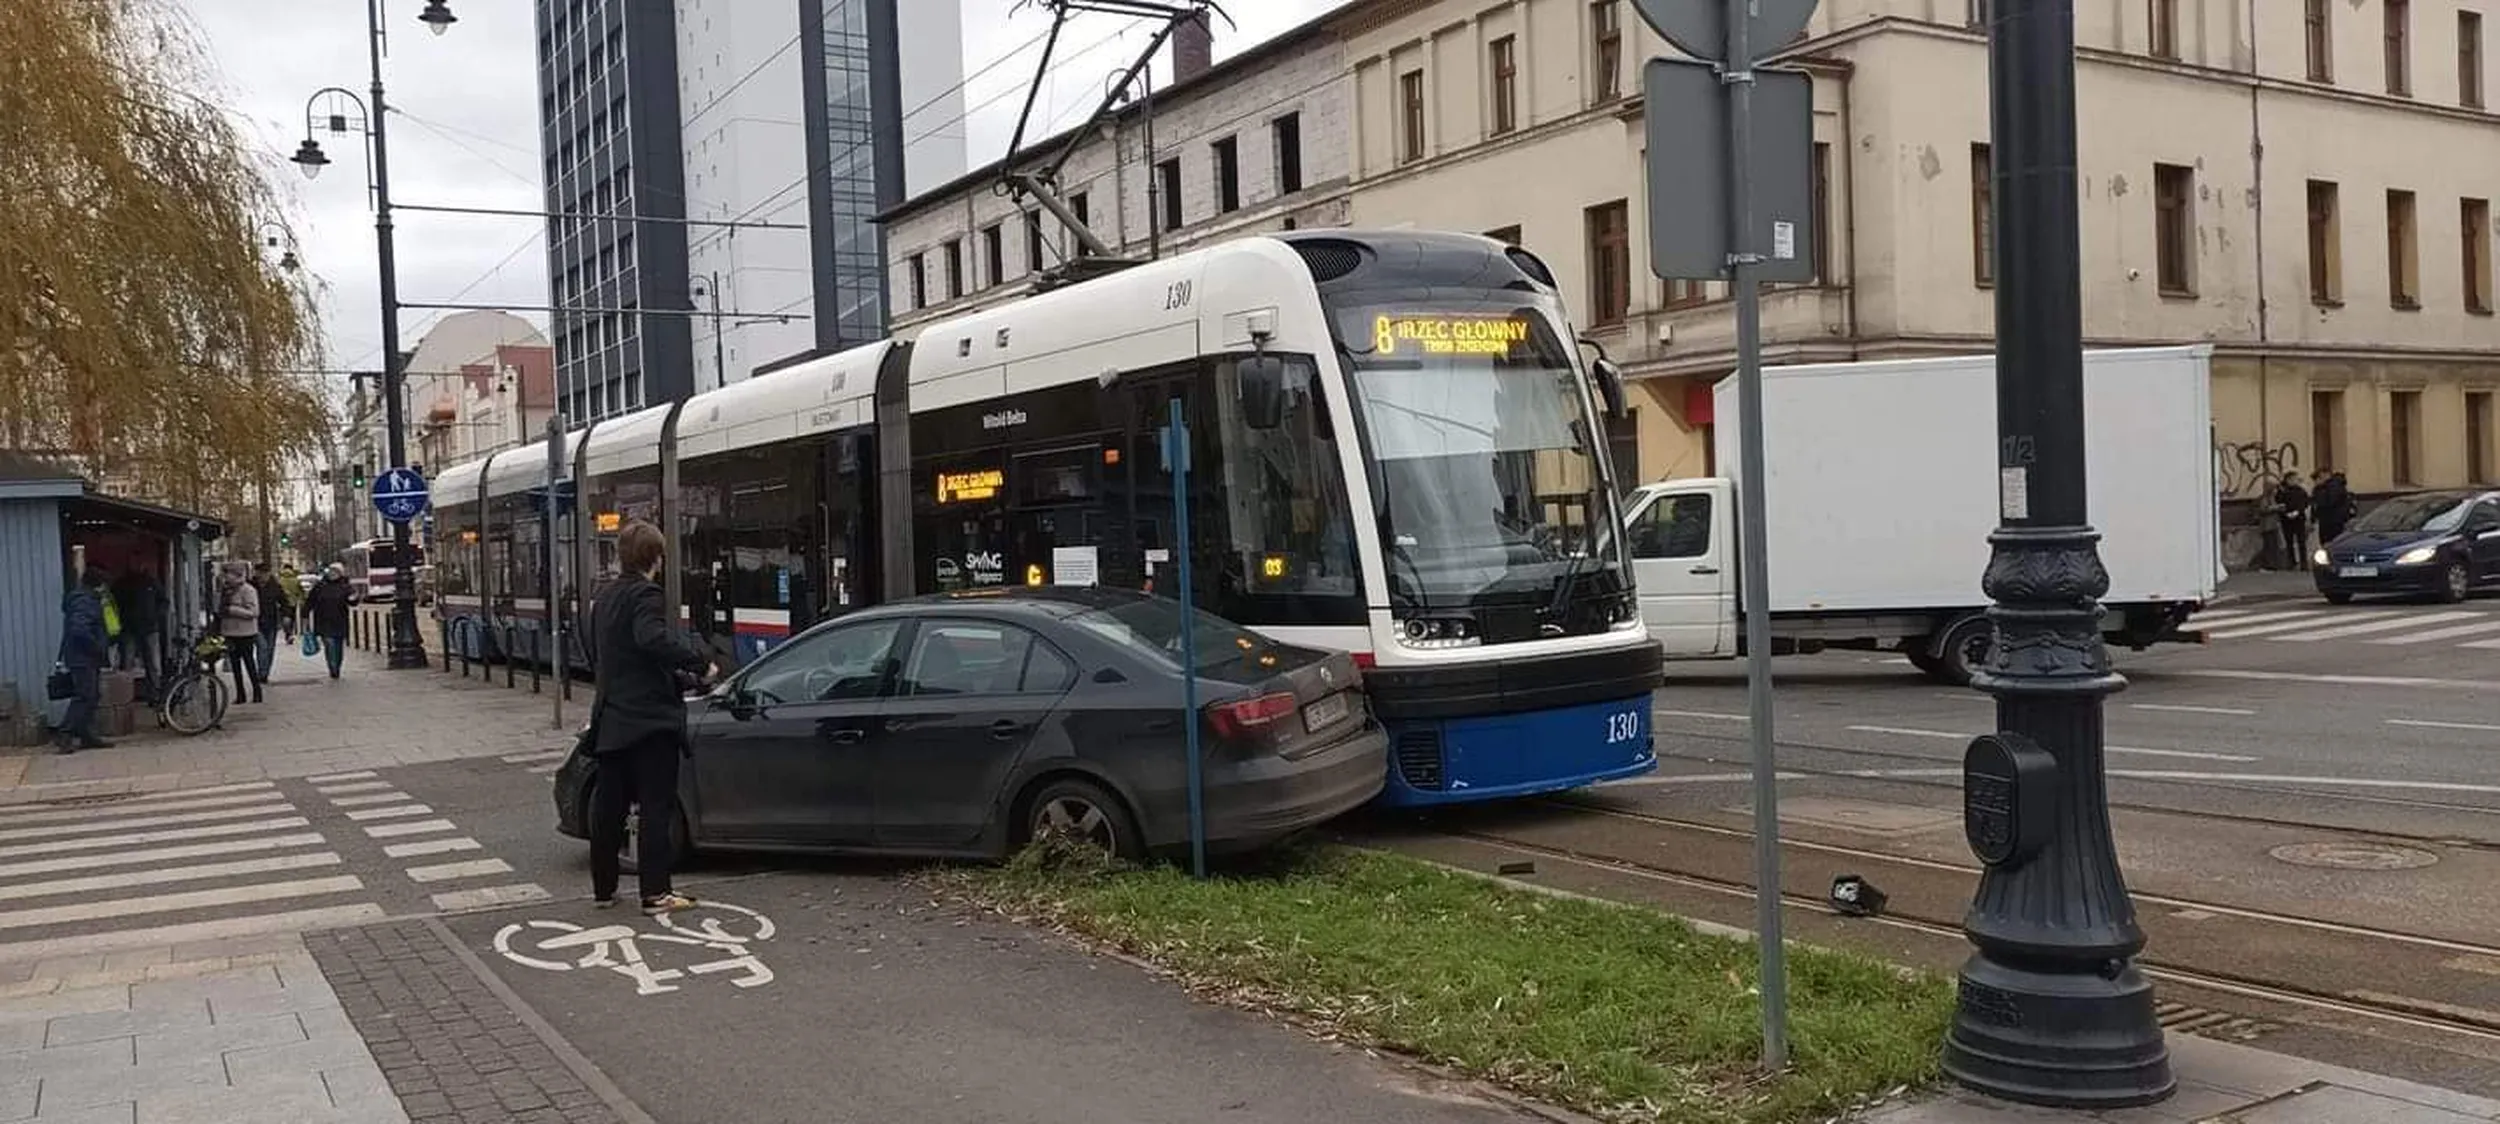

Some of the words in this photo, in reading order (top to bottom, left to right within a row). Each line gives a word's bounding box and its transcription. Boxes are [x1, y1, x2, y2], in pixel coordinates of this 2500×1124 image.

[1165, 280, 1192, 310] 130
[1376, 316, 1394, 354] 8
[1606, 711, 1638, 743] 130
